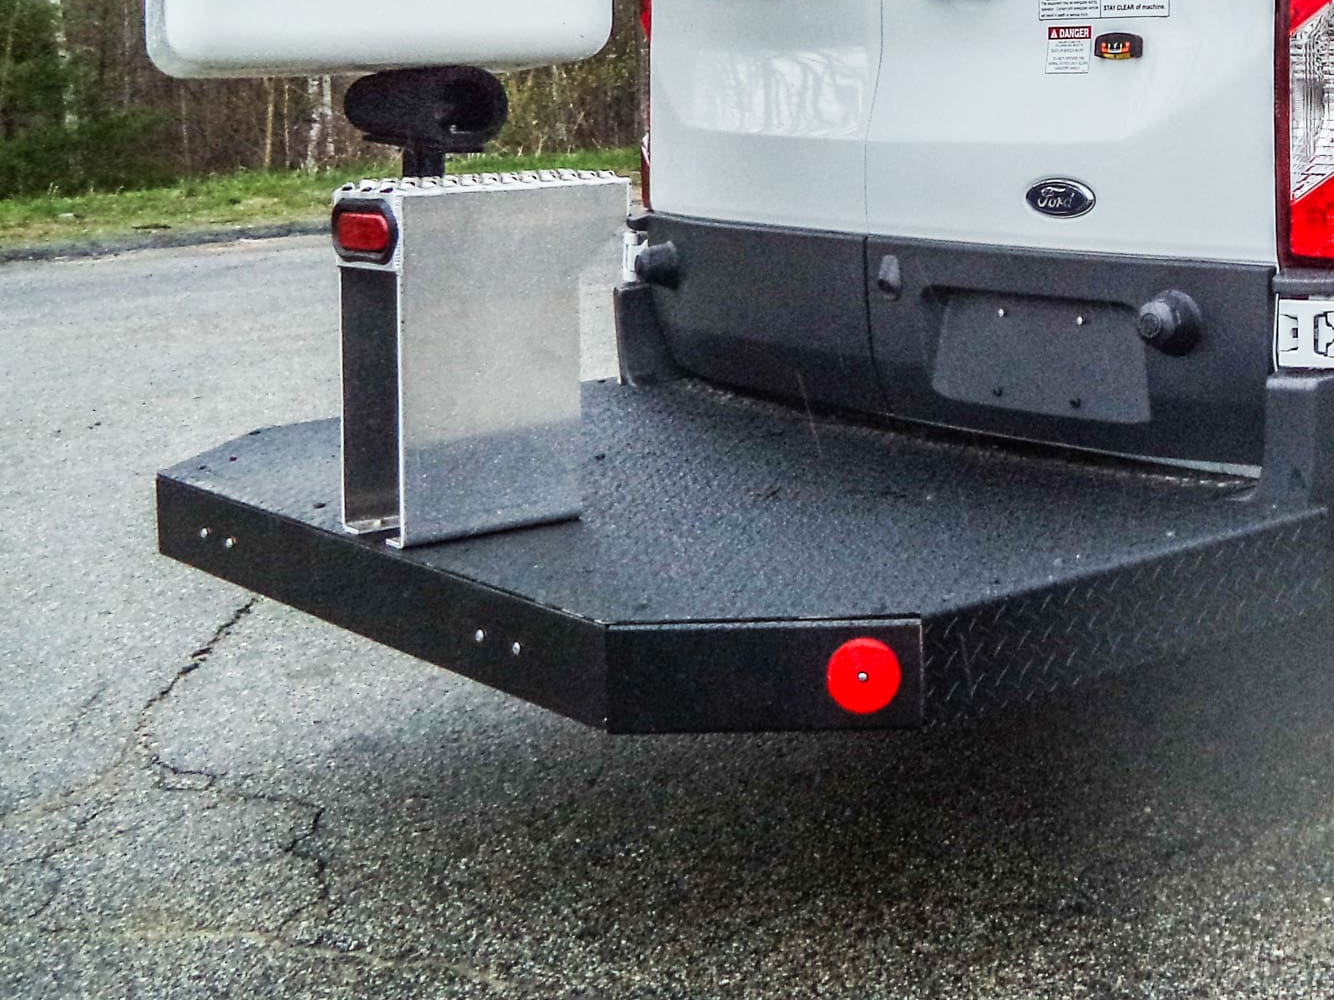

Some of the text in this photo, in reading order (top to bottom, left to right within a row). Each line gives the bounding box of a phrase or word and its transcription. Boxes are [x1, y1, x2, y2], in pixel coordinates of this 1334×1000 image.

[1116, 3, 1134, 11] CLEAR
[1059, 27, 1089, 38] DANGER
[1037, 186, 1075, 208] Ford
